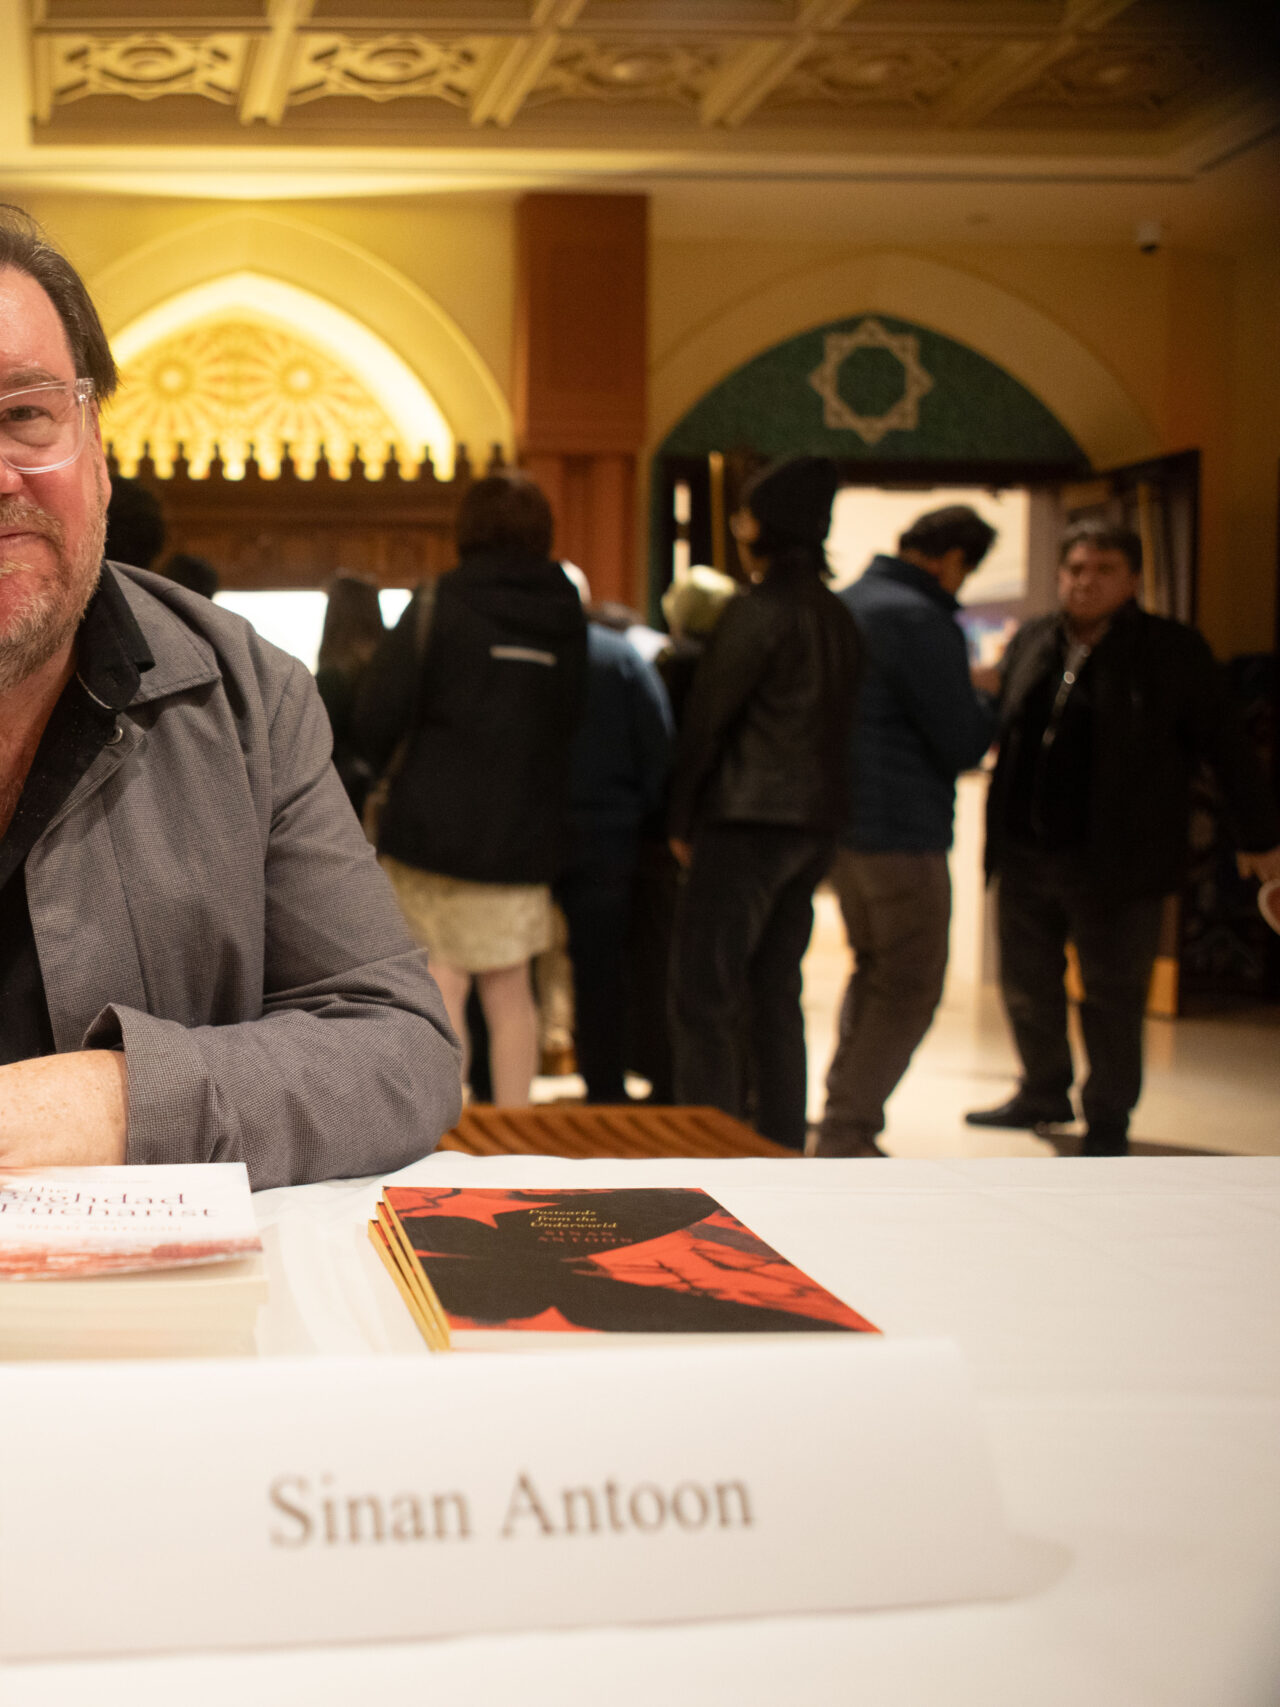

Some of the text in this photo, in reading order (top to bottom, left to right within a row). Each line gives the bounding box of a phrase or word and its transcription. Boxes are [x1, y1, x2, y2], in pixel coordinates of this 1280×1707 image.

[1, 1203, 219, 1218] Eucharist
[268, 1468, 755, 1550] Sinan Antoon
